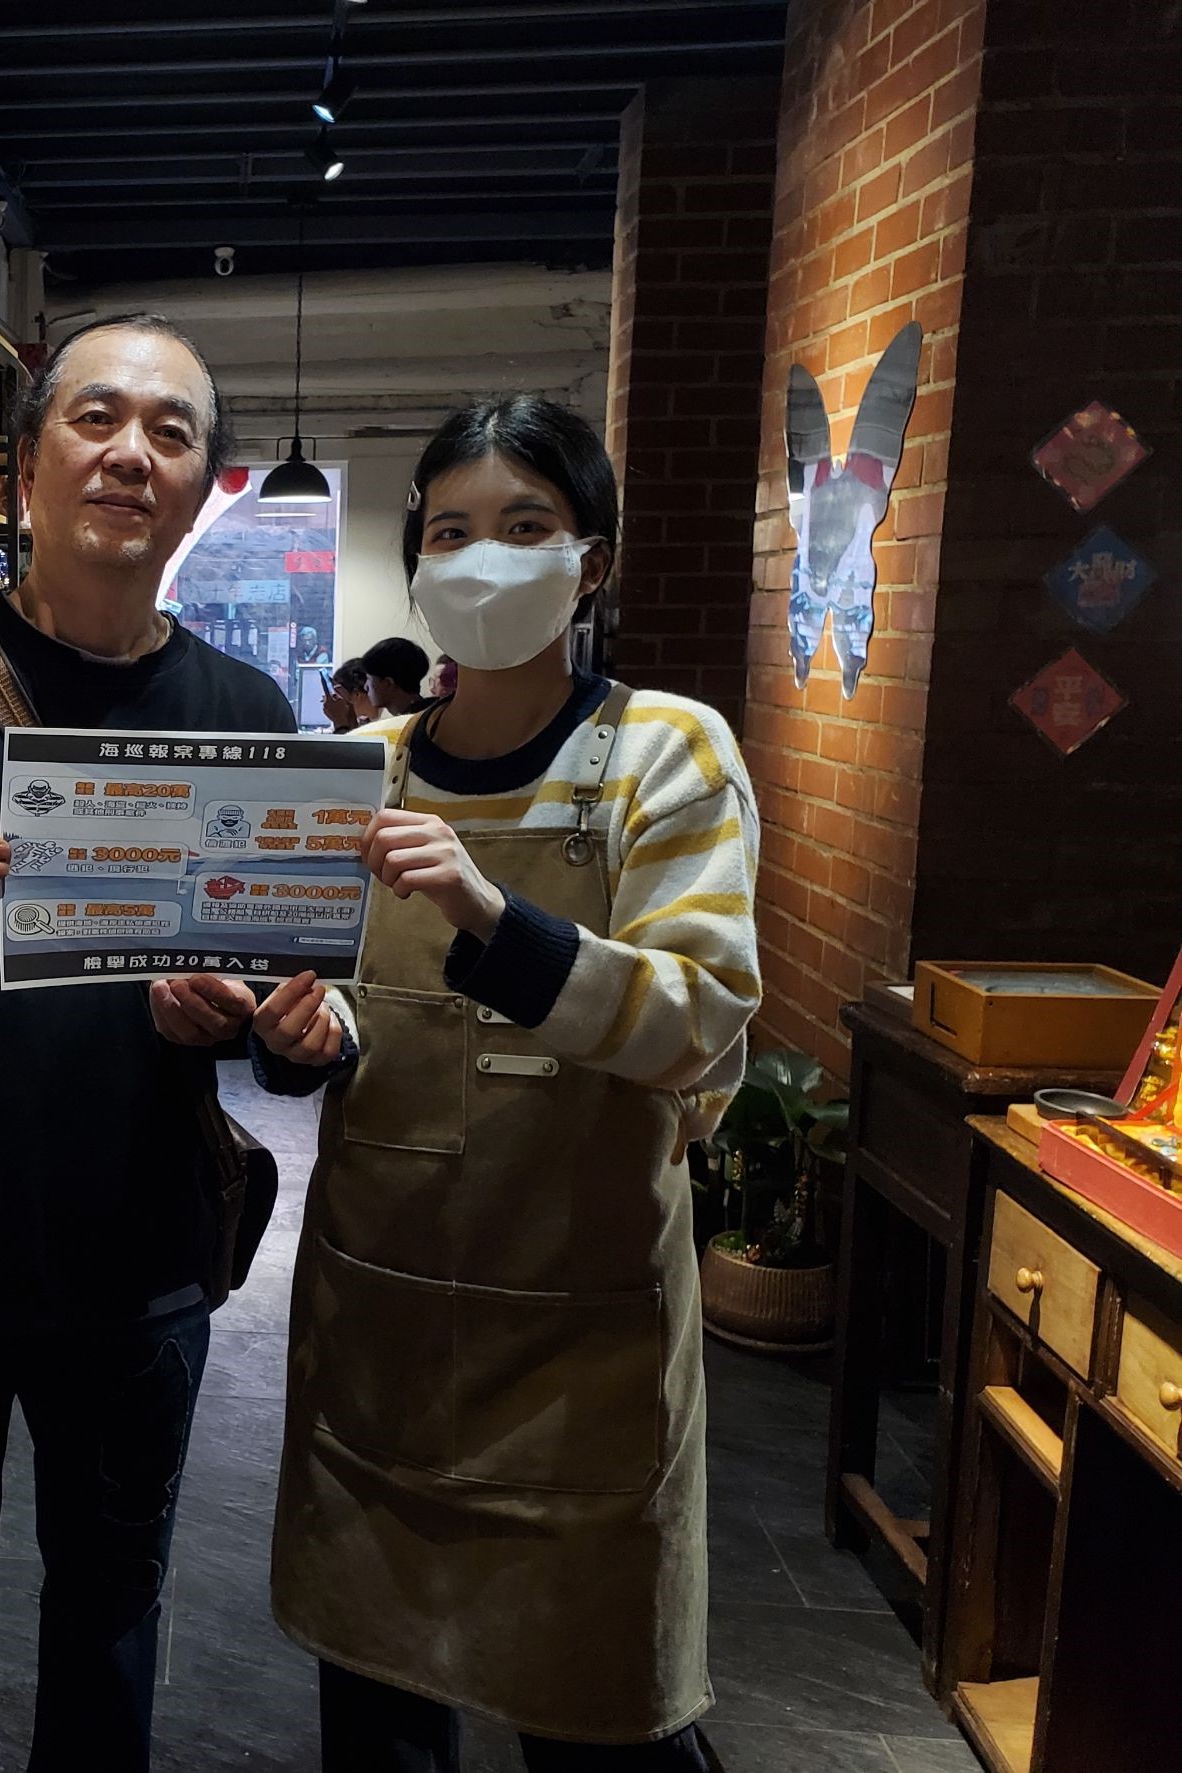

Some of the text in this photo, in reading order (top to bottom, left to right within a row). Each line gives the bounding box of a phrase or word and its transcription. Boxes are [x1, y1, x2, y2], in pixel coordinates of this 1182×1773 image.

[98, 742, 286, 760] 海巡報案專線118
[92, 847, 181, 862] 3000元
[272, 883, 361, 900] 3000元
[83, 954, 270, 970] 檢舉成功20萬入袋
